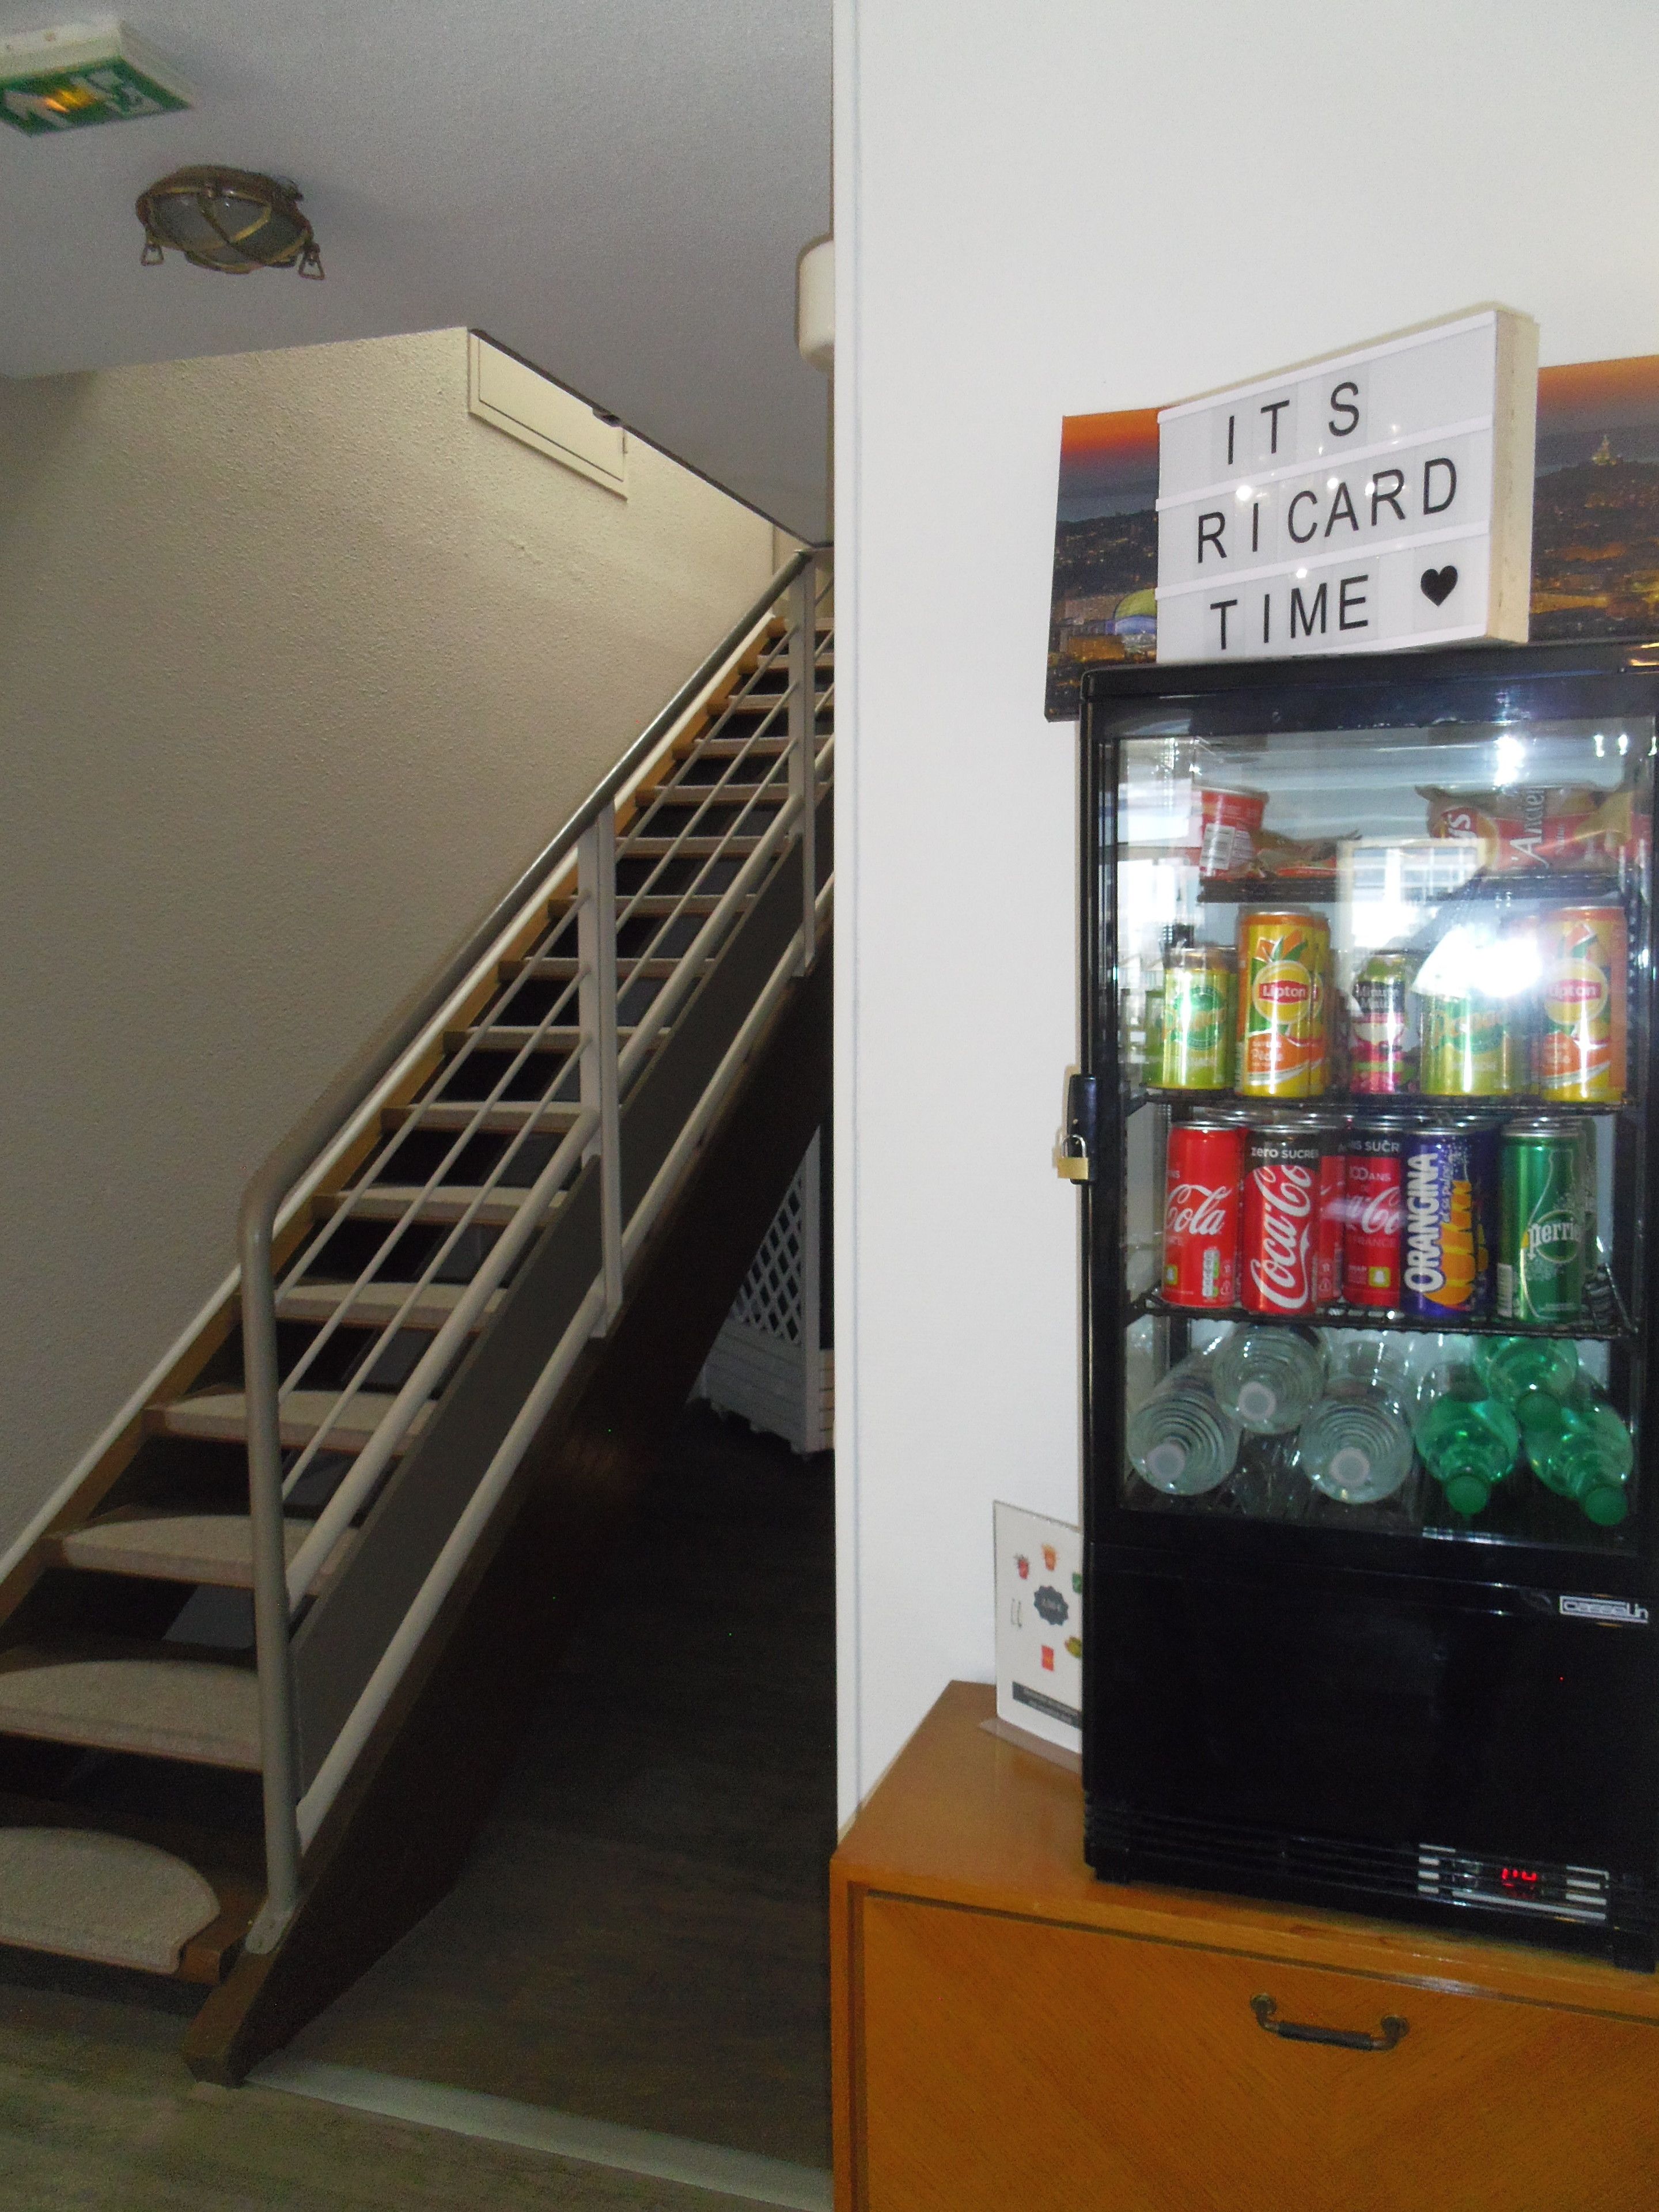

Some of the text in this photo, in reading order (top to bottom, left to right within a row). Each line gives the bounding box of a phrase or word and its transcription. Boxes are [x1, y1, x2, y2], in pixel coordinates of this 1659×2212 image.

[1197, 457, 1457, 564] RICARD
[1210, 575, 1369, 650] TIME
[1263, 984, 1306, 999] Lipton
[1251, 1146, 1279, 1158] zero
[1404, 1153, 1445, 1293] ORANGINA
